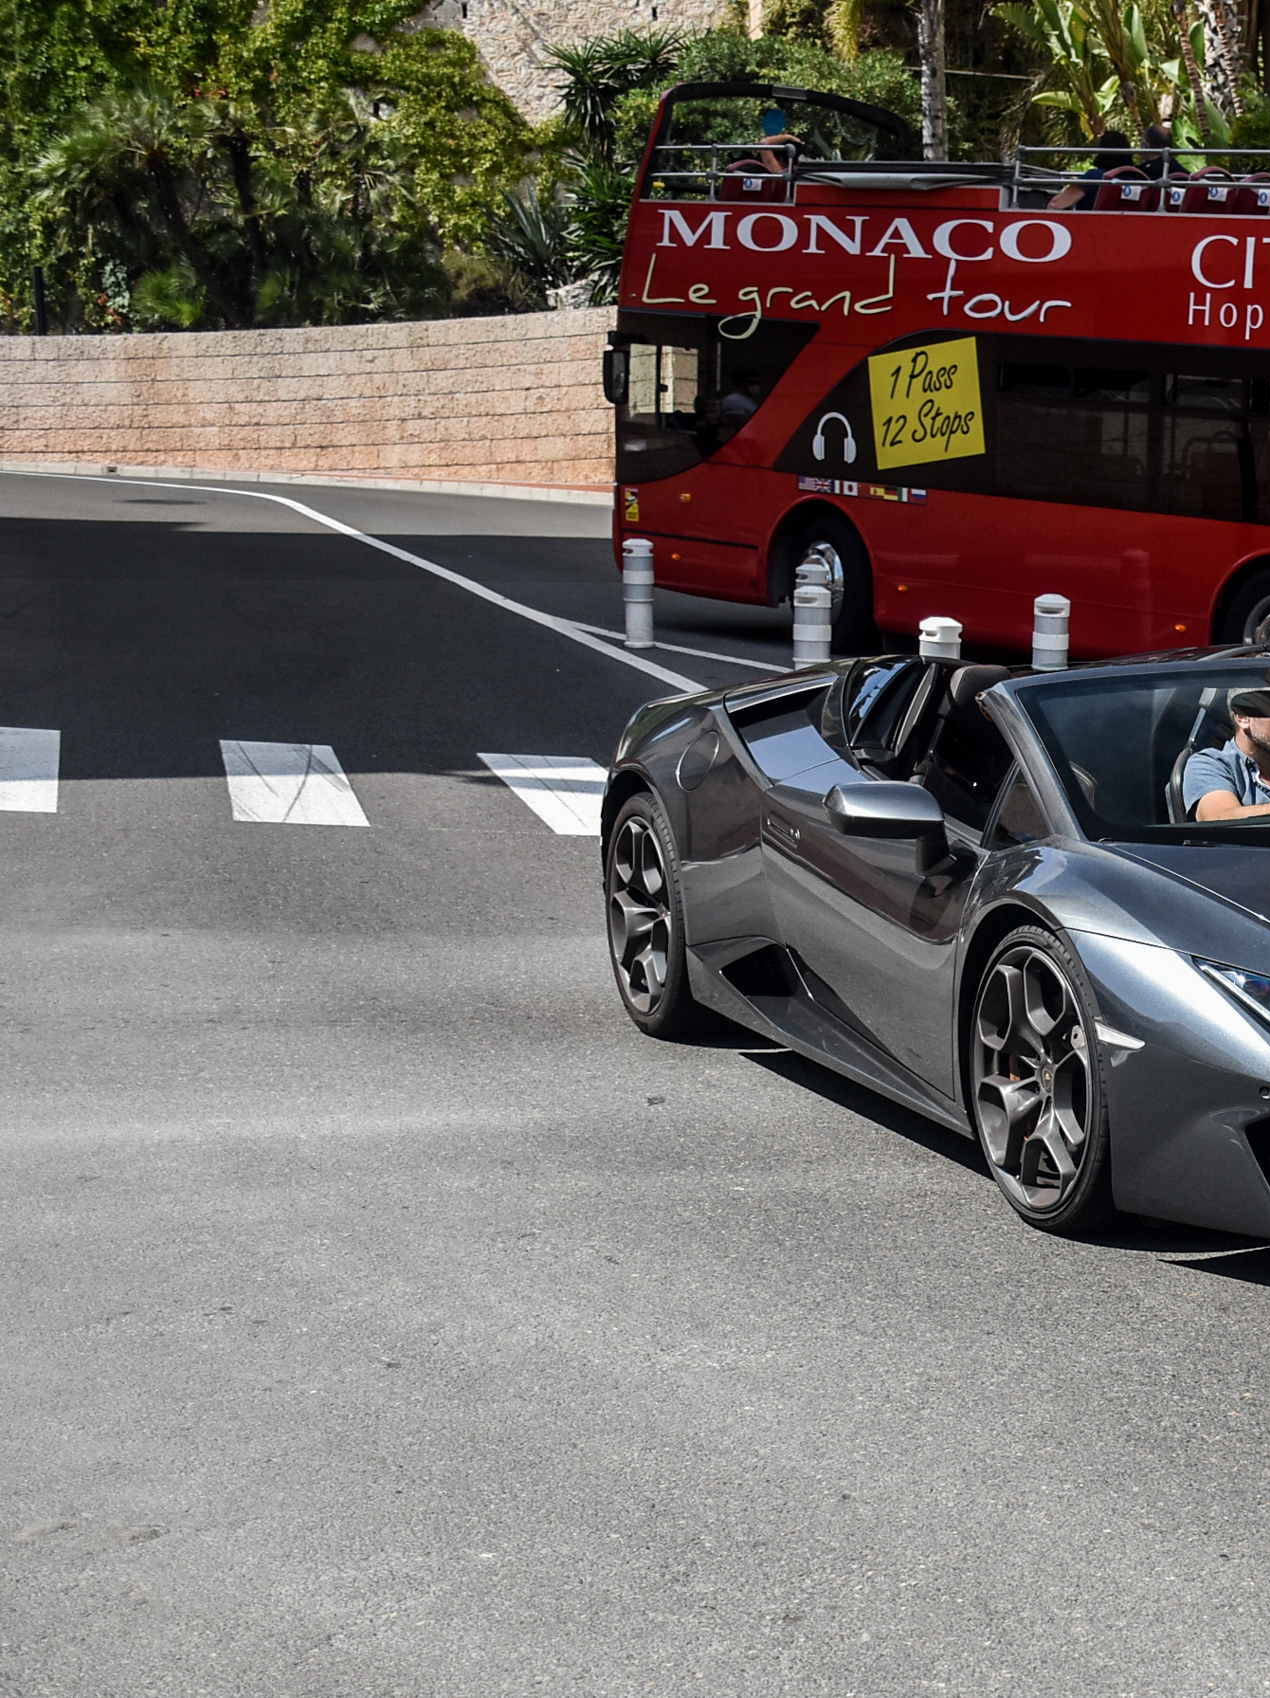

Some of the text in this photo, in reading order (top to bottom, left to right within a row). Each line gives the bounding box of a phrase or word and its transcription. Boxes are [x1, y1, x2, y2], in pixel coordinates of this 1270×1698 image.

[656, 209, 1072, 263] MONACO
[642, 254, 1072, 339] Le grand tour
[1188, 292, 1264, 340] Hop
[906, 351, 958, 398] Pass
[881, 401, 976, 453] 12 Stops
